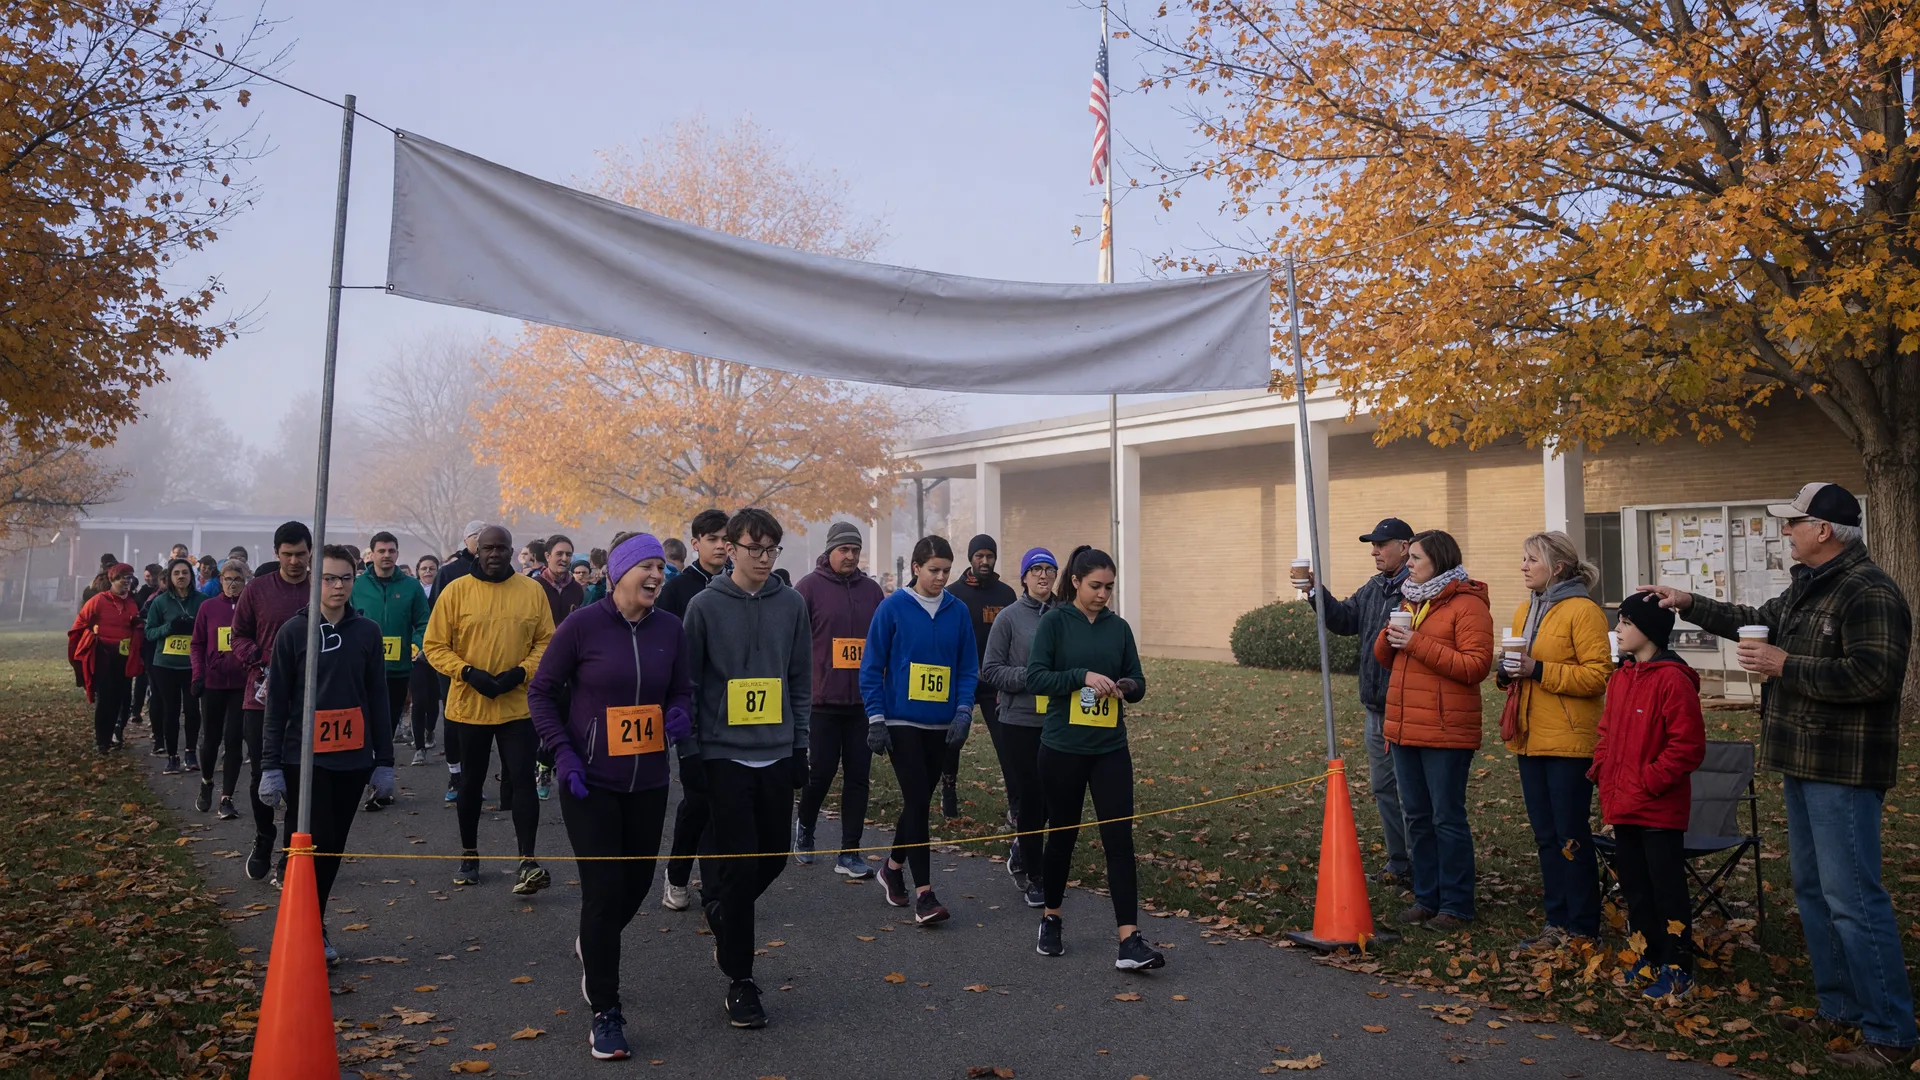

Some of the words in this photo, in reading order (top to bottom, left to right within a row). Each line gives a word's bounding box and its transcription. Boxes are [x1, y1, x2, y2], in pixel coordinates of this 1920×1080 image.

[920, 673, 943, 692] 156
[745, 690, 767, 713] 87
[319, 719, 353, 742] 214
[620, 717, 654, 742] 214
